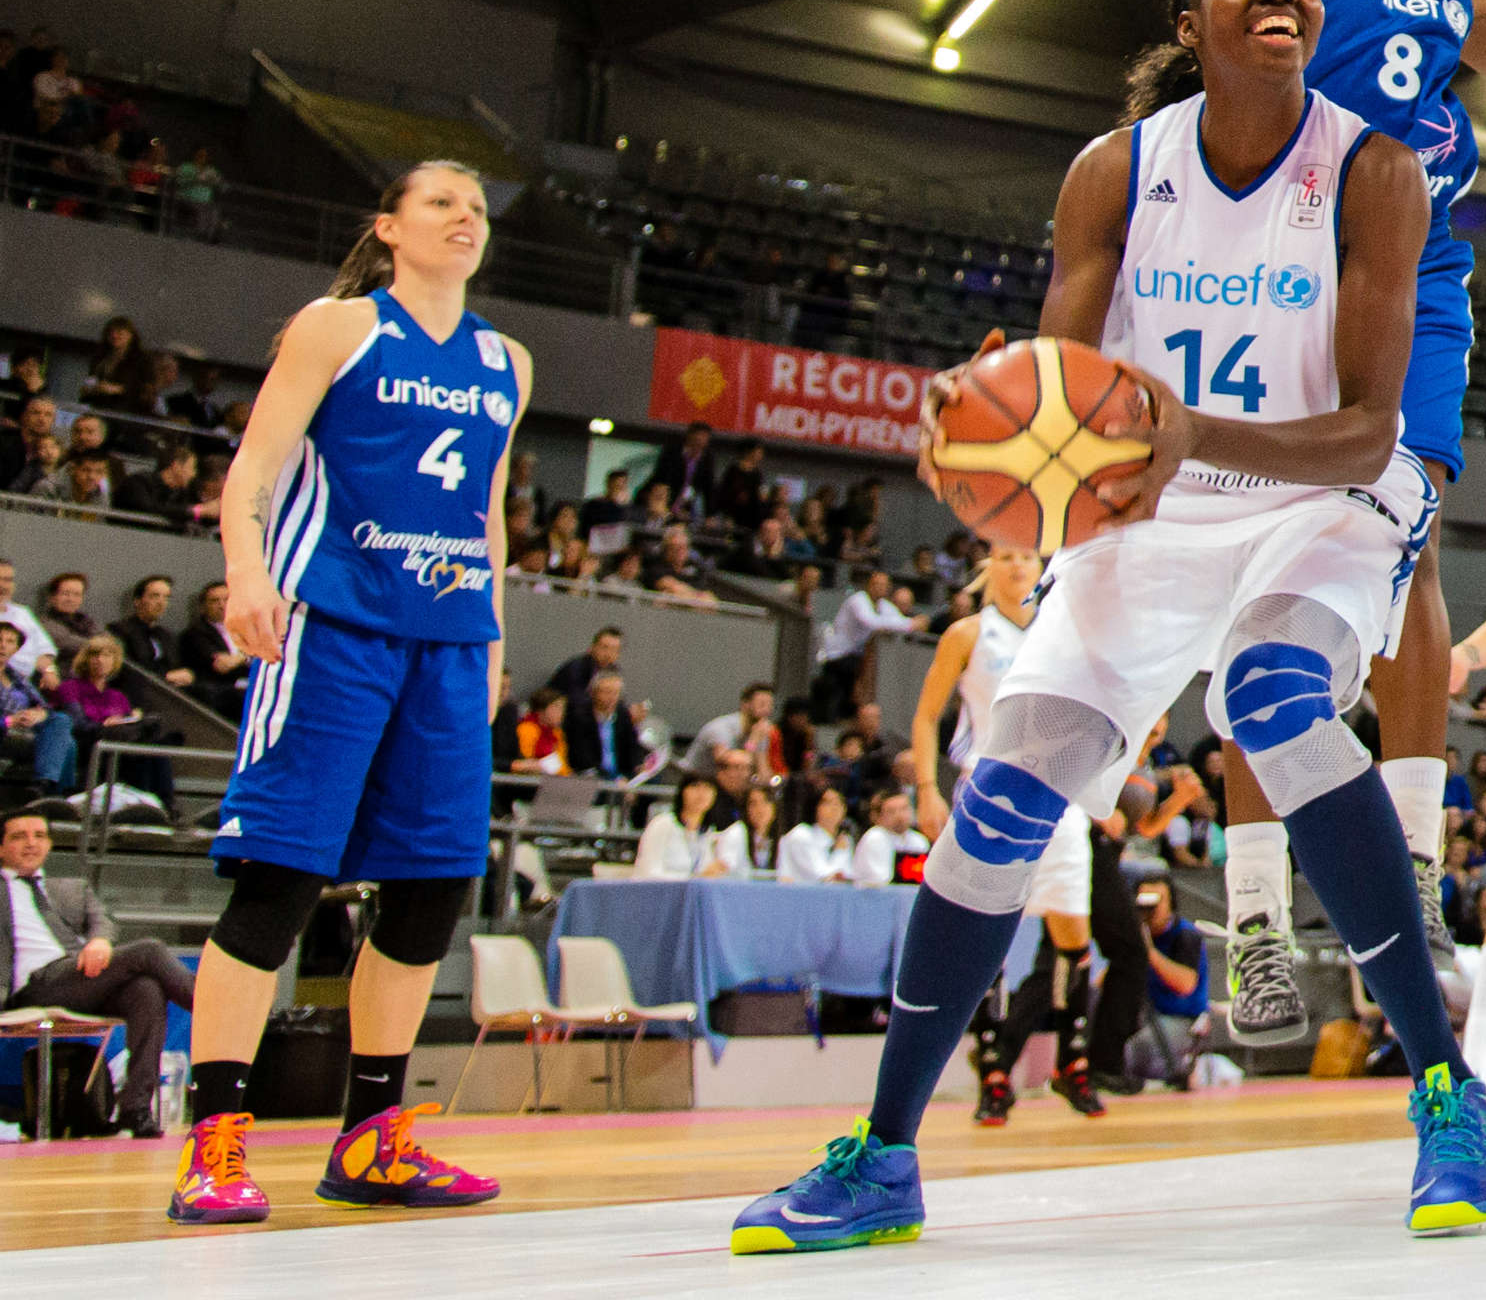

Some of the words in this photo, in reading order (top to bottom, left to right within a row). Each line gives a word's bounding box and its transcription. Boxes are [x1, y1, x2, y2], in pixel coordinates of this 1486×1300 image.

[1377, 33, 1423, 101] 8
[1134, 260, 1266, 306] unicef
[377, 376, 481, 416] unicef
[1164, 329, 1267, 413] 14
[417, 428, 467, 491] 4
